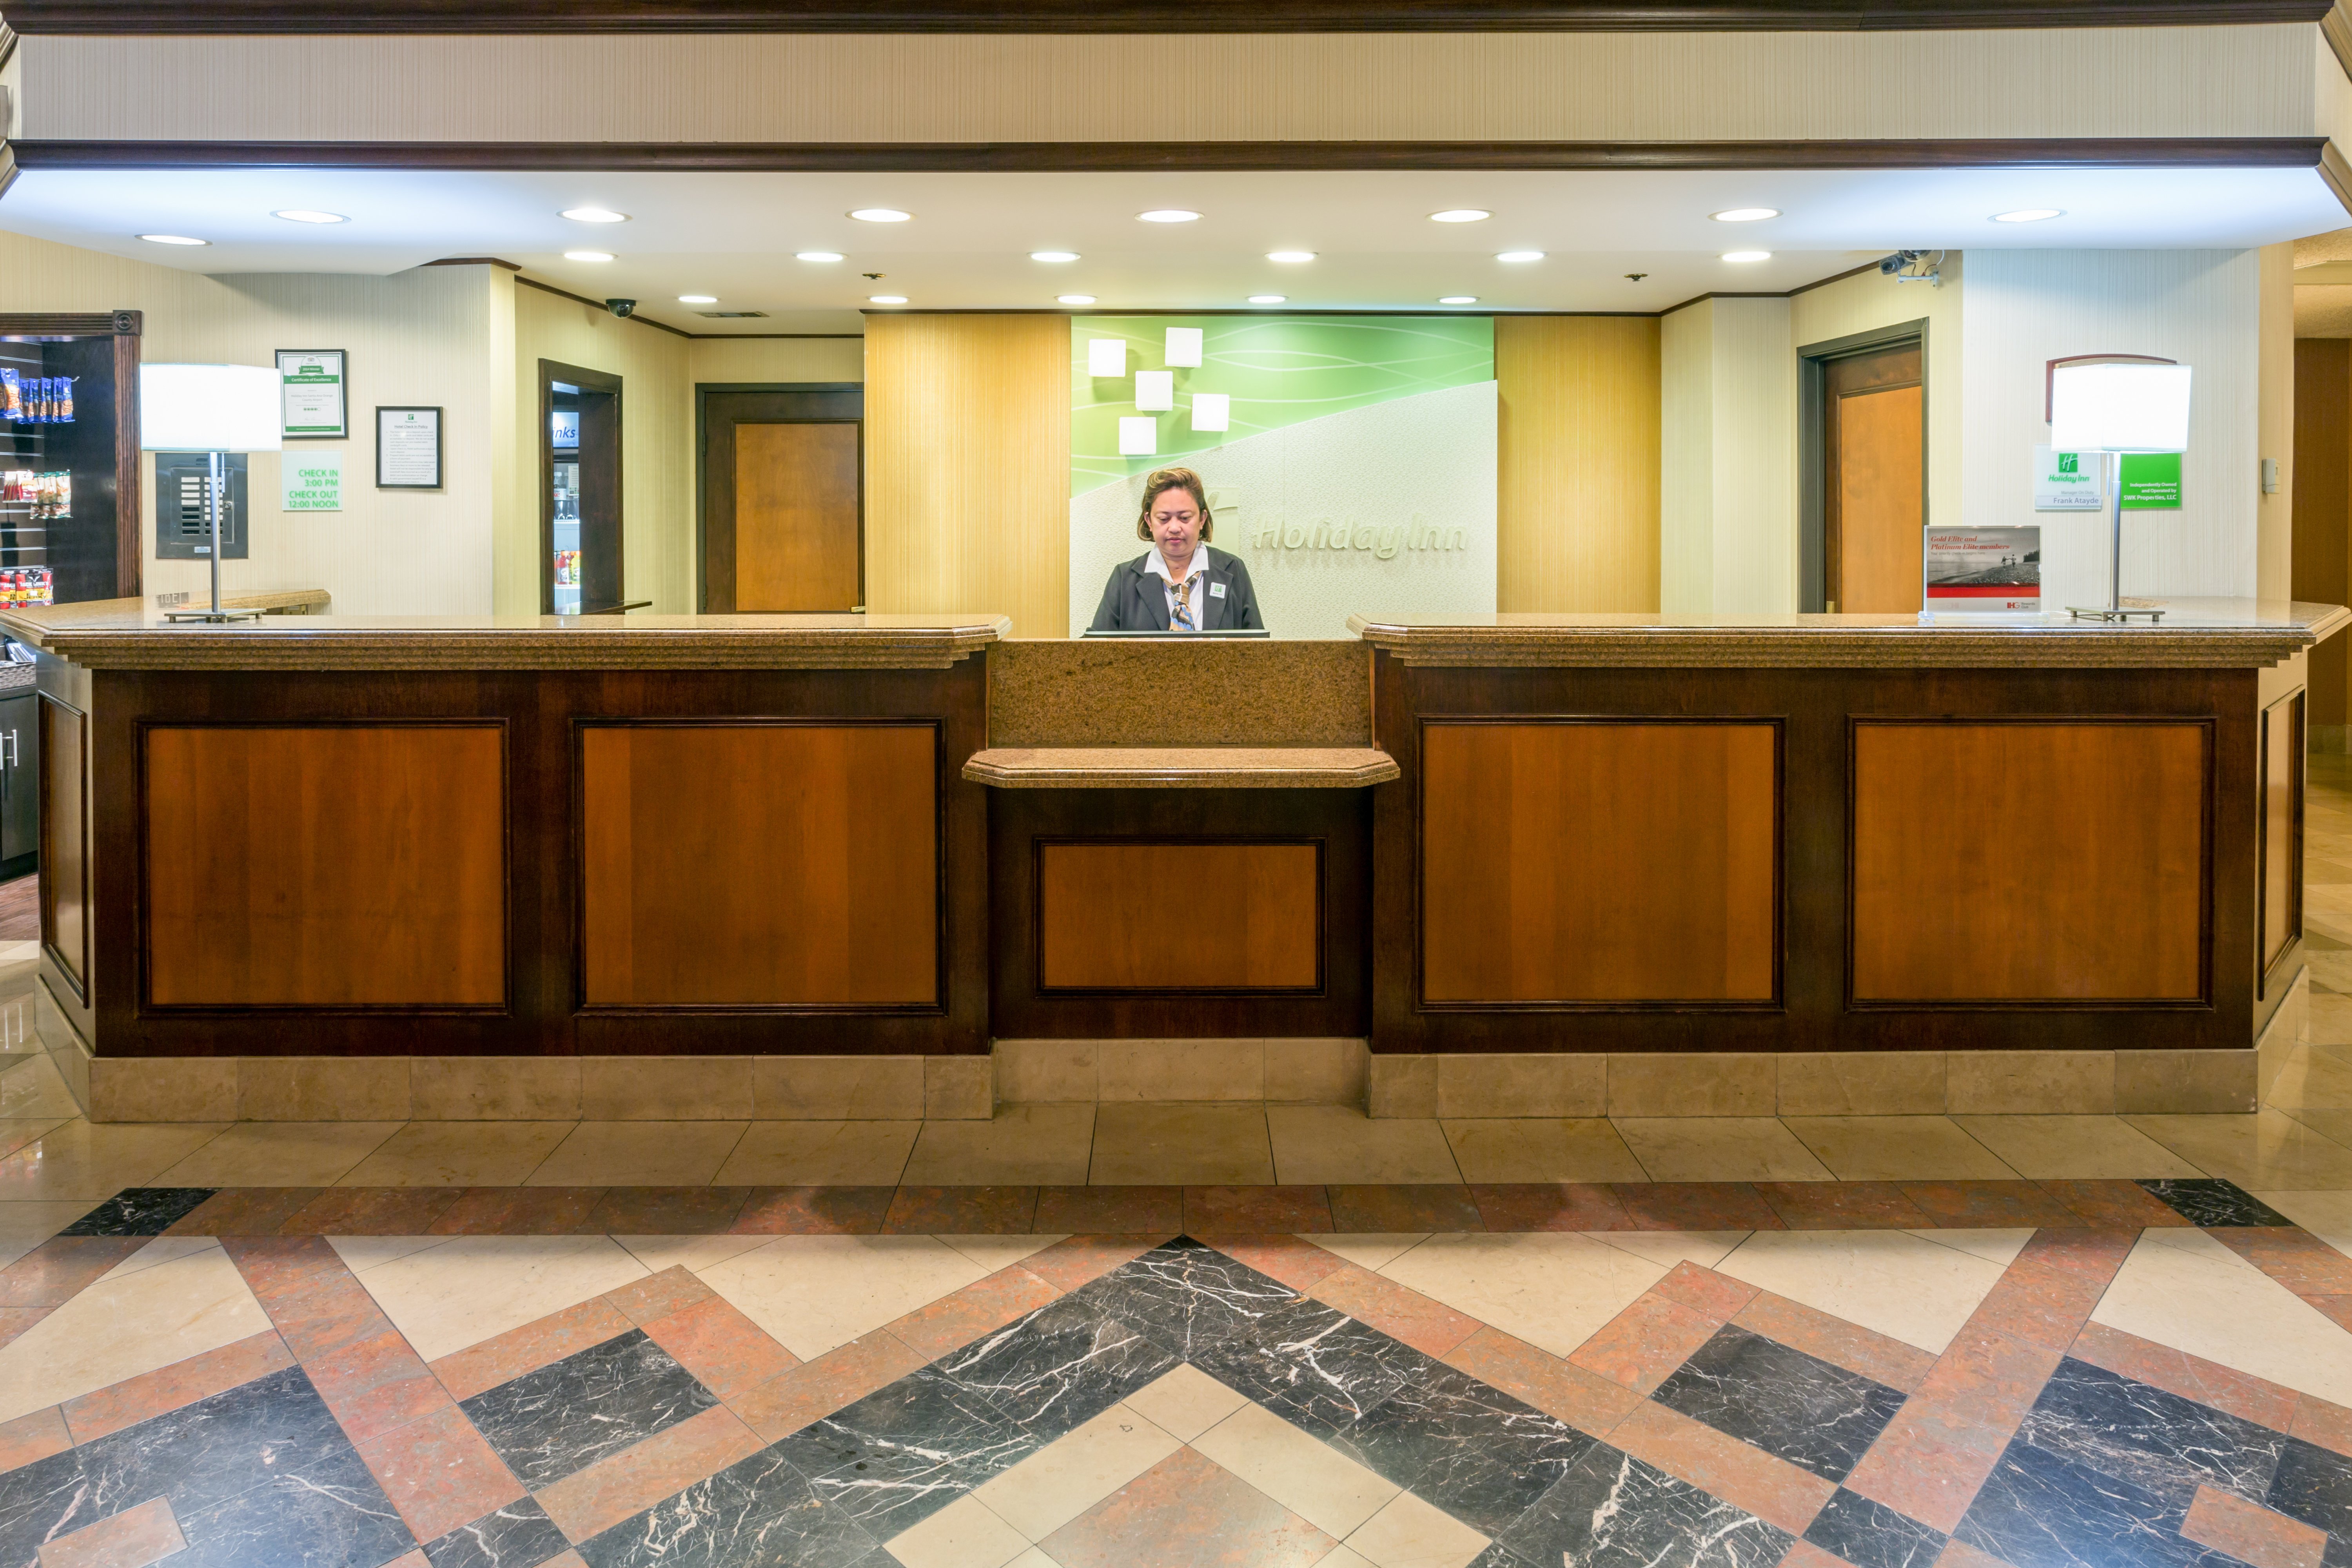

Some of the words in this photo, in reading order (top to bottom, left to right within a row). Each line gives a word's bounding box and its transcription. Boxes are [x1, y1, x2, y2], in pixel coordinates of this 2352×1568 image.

[2048, 474, 2077, 483] Holiday
[1254, 513, 1403, 559] Holiday
[1409, 513, 1468, 550] Inn
